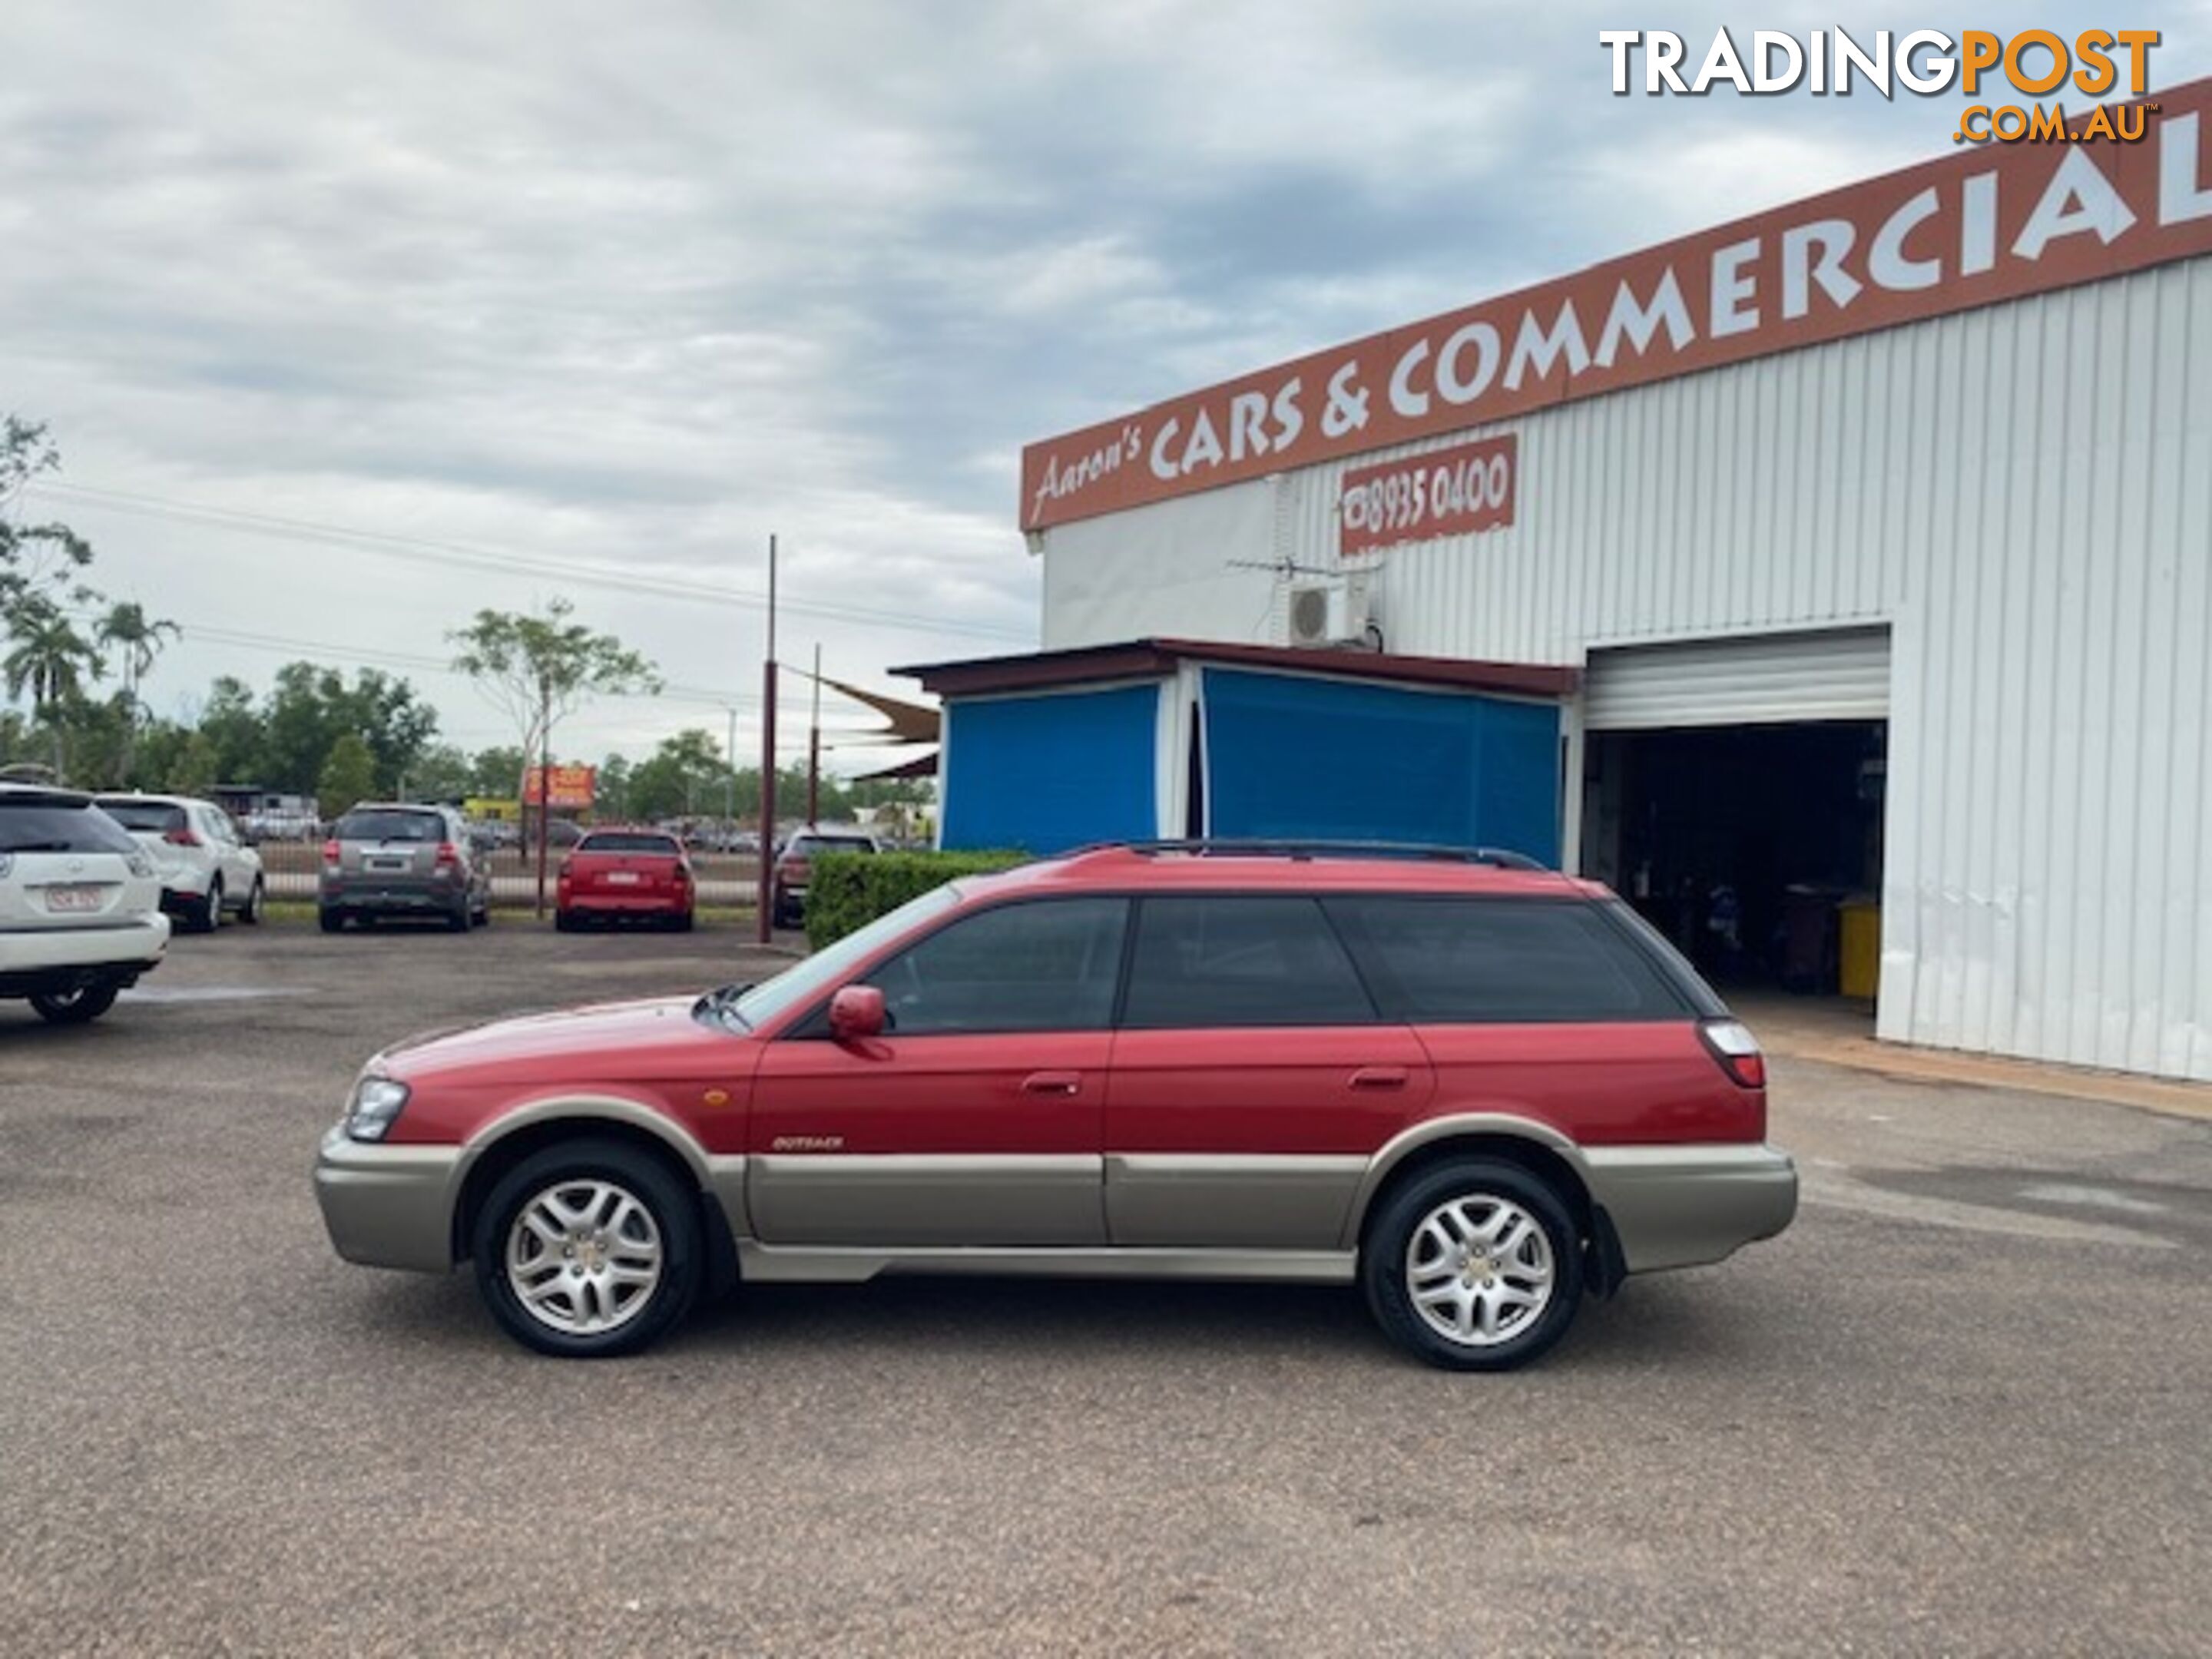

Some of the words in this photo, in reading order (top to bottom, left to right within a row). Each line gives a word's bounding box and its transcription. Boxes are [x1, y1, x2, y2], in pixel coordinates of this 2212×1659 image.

[1029, 425, 1142, 526] Aaron's
[1150, 376, 1305, 479] CARS
[1320, 359, 1370, 439] &
[1389, 110, 2212, 417] COMMERCIAL
[1367, 468, 1427, 534] 8935
[1430, 452, 1508, 520] 0400
